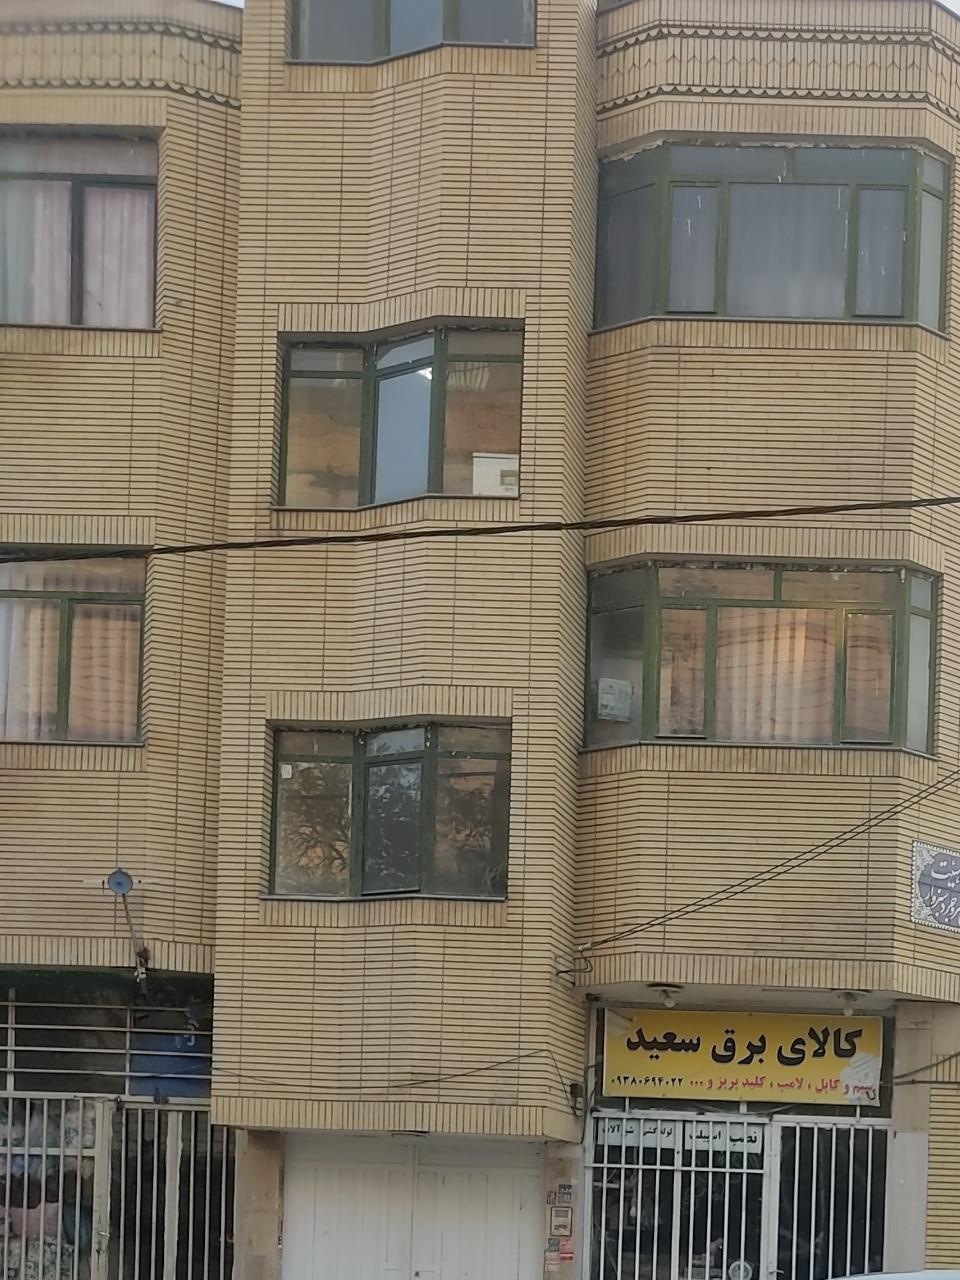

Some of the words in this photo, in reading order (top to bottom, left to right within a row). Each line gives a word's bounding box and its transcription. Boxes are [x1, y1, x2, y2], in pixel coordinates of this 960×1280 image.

[625, 1026, 701, 1060] سعید
[710, 1028, 767, 1065] برق
[776, 1026, 863, 1066] کالای
[741, 1075, 766, 1090] کلید
[729, 1131, 758, 1147] نصب
